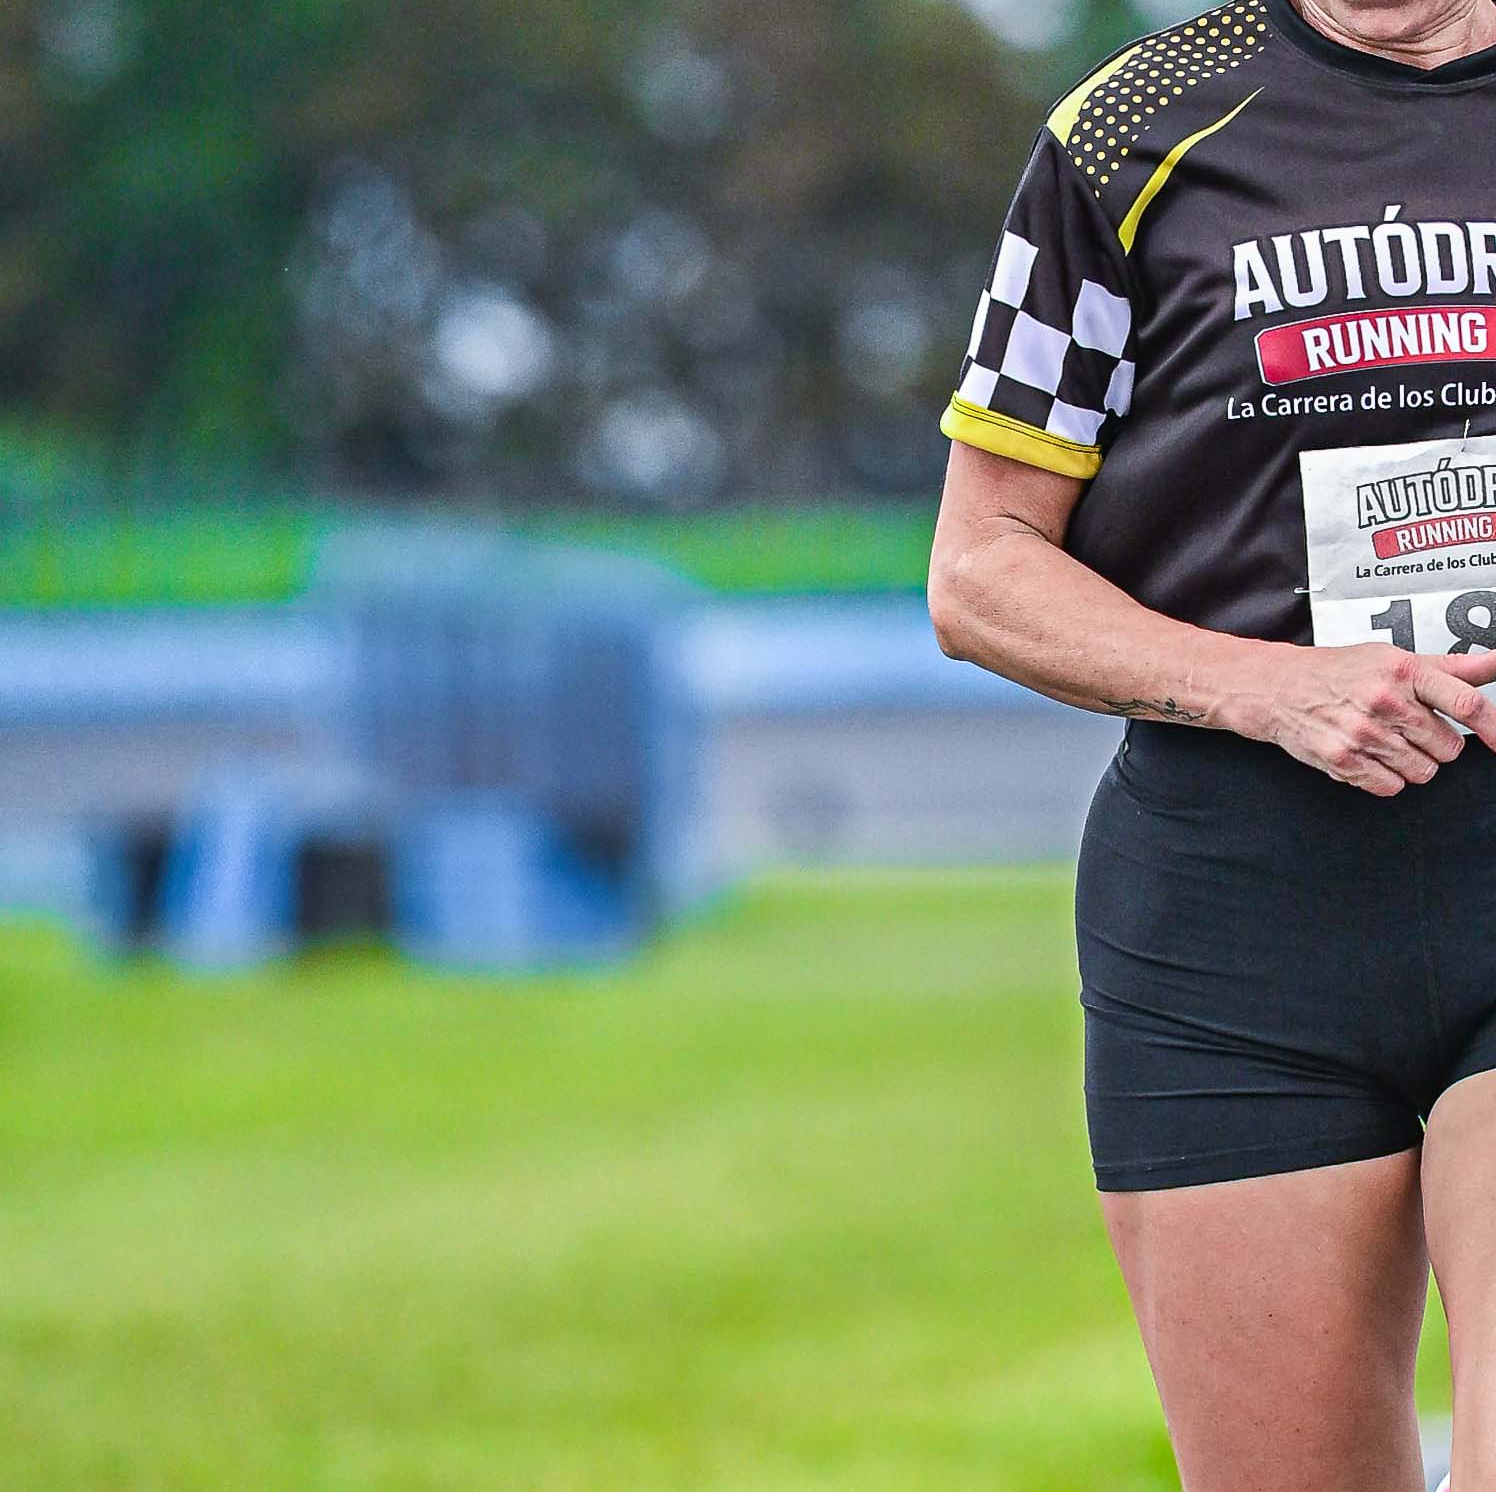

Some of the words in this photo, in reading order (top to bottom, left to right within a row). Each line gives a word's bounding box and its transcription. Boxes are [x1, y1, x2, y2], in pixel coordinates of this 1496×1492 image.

[1301, 312, 1489, 373] RUNNING
[1227, 396, 1255, 420] La
[1261, 393, 1354, 417] Carrera
[1360, 385, 1392, 410] de
[1399, 384, 1435, 408] los
[1395, 514, 1494, 553] RUNNING
[1356, 565, 1371, 579] La
[1374, 563, 1424, 577] Carrera
[1426, 559, 1444, 572] de
[1447, 556, 1466, 570] los
